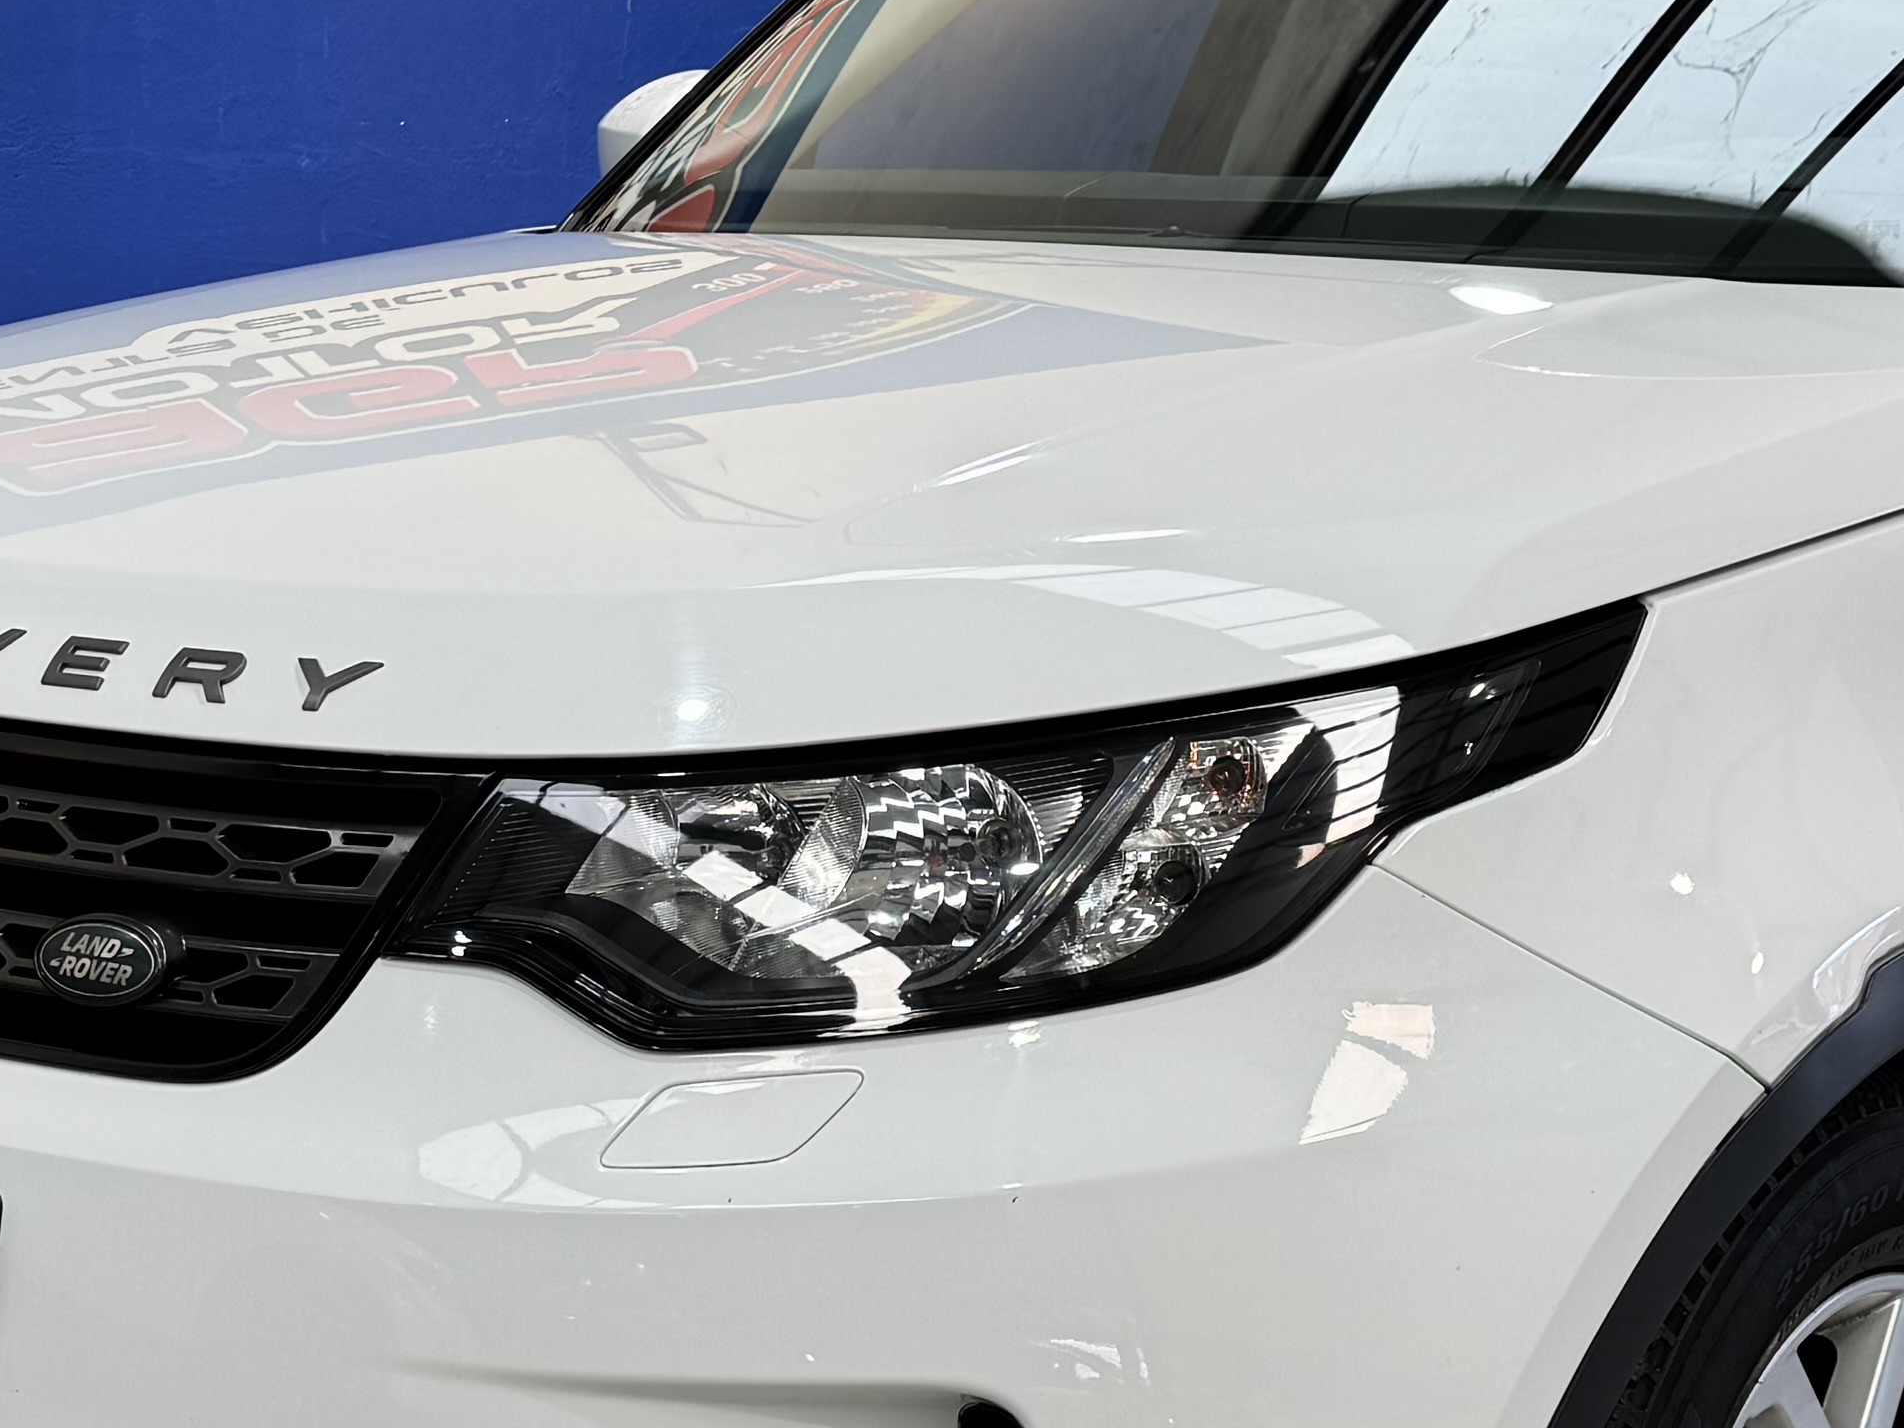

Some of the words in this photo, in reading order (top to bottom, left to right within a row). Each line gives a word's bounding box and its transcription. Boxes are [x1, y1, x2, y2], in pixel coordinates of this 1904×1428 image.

[60, 932, 122, 960] LAND
[59, 955, 134, 987] ROVER
[1776, 1184, 1890, 1311] 255/60
